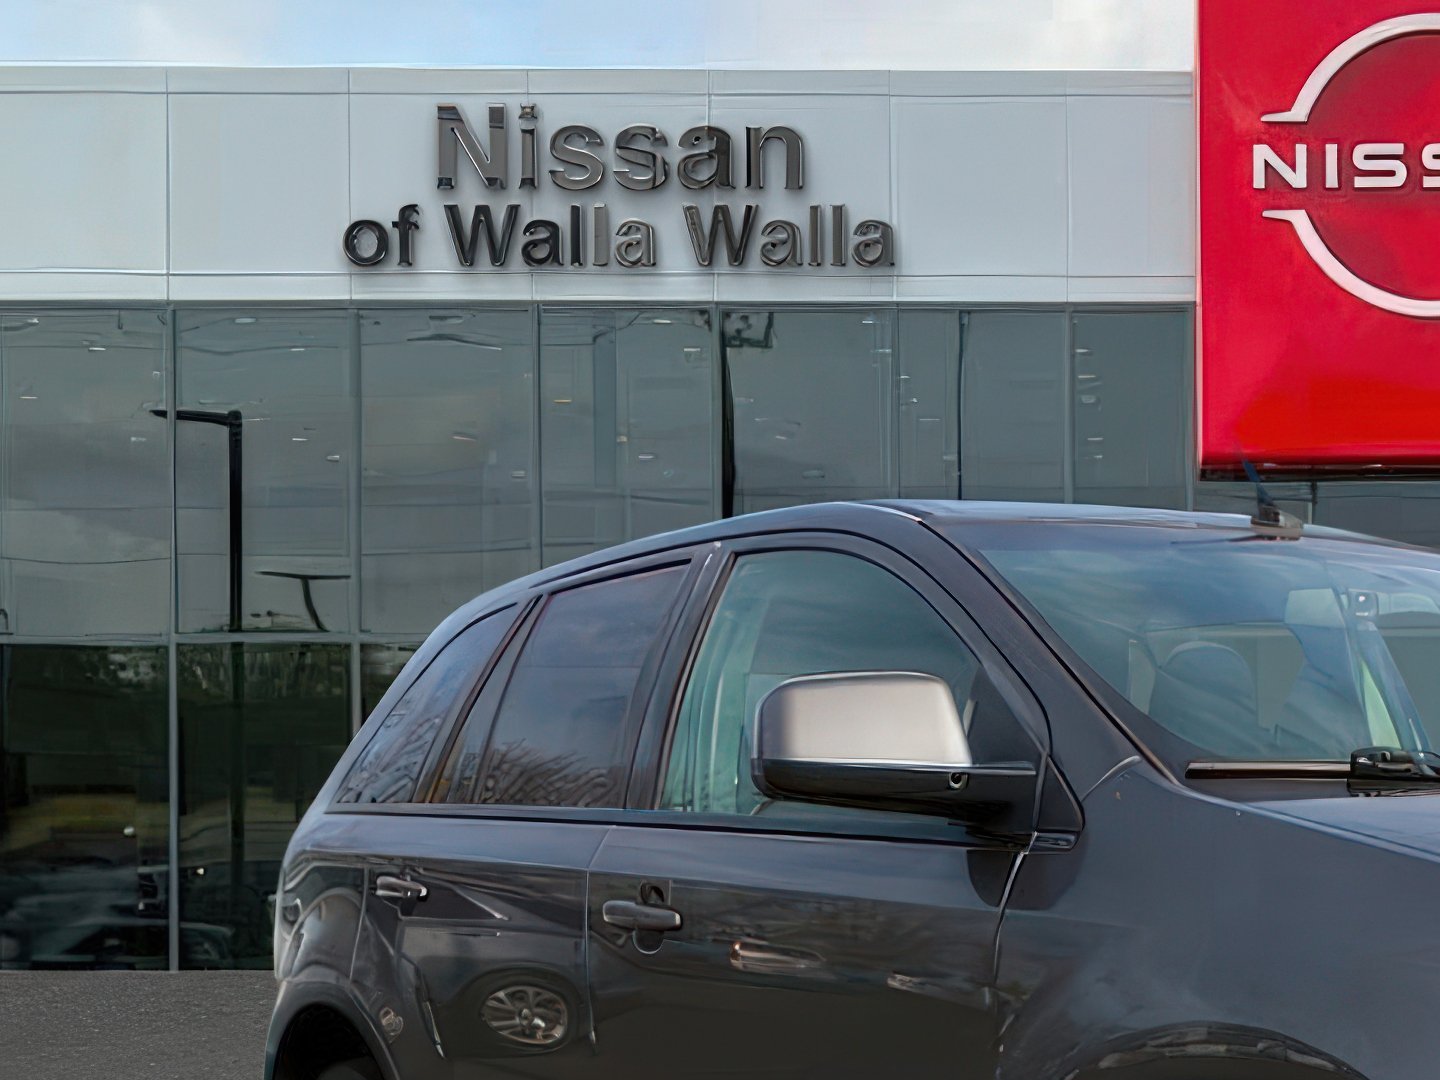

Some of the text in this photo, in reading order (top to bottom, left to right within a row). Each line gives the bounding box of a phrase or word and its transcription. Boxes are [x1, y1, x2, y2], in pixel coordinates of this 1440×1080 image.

[436, 102, 804, 190] Nissan
[342, 203, 896, 267] of Walla Walla
